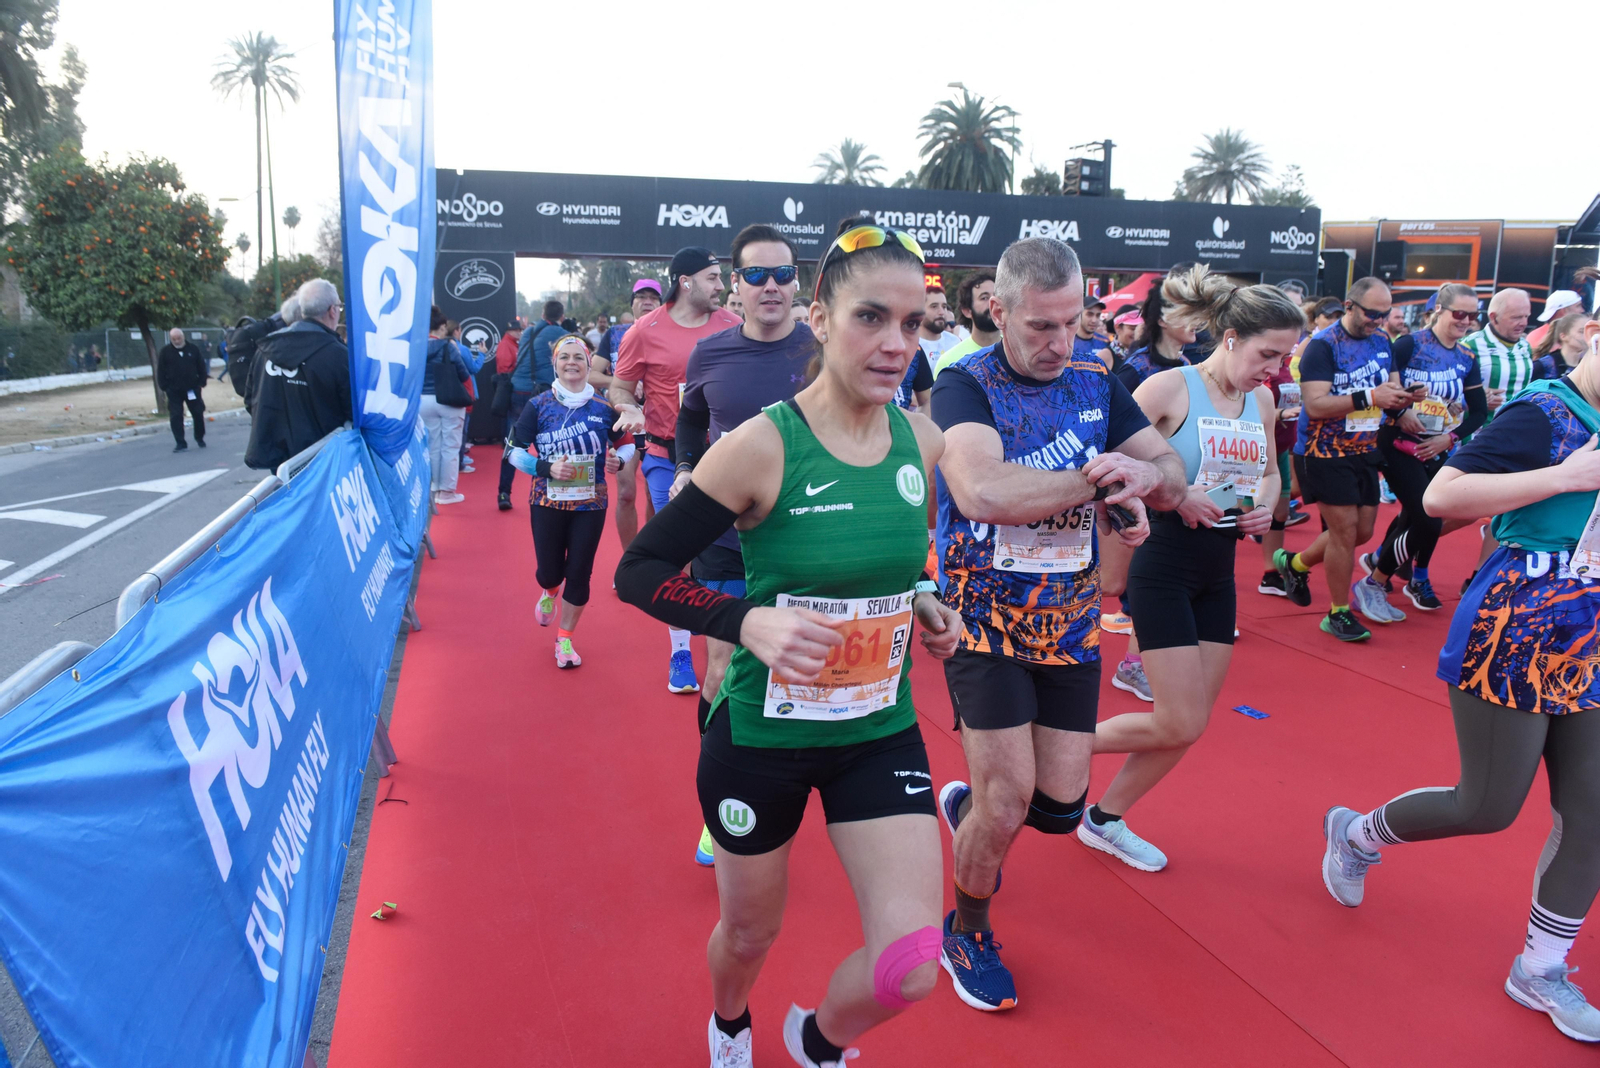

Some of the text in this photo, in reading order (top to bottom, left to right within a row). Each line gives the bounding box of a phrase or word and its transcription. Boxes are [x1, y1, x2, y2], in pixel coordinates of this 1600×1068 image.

[356, 2, 376, 76] FLY
[563, 204, 621, 216] HYUNDAI
[657, 203, 729, 228] HOKA
[884, 210, 971, 229] maratón
[601, 217, 621, 225] Motor
[1019, 219, 1080, 242] HOKA
[907, 225, 972, 245] sevilla
[1125, 228, 1170, 239] HYUNDAI
[357, 96, 418, 421] HOKA
[934, 249, 955, 258] 2024
[1078, 408, 1103, 424] HOKA
[1207, 435, 1259, 463] 14400
[330, 462, 381, 573] HOKA
[812, 601, 848, 614] MARATÓN
[866, 596, 901, 615] SEVILLA
[829, 706, 849, 715] HOKA
[167, 576, 309, 883] HOKA
[245, 867, 286, 984] FLY
[267, 750, 322, 907] HUMAN
